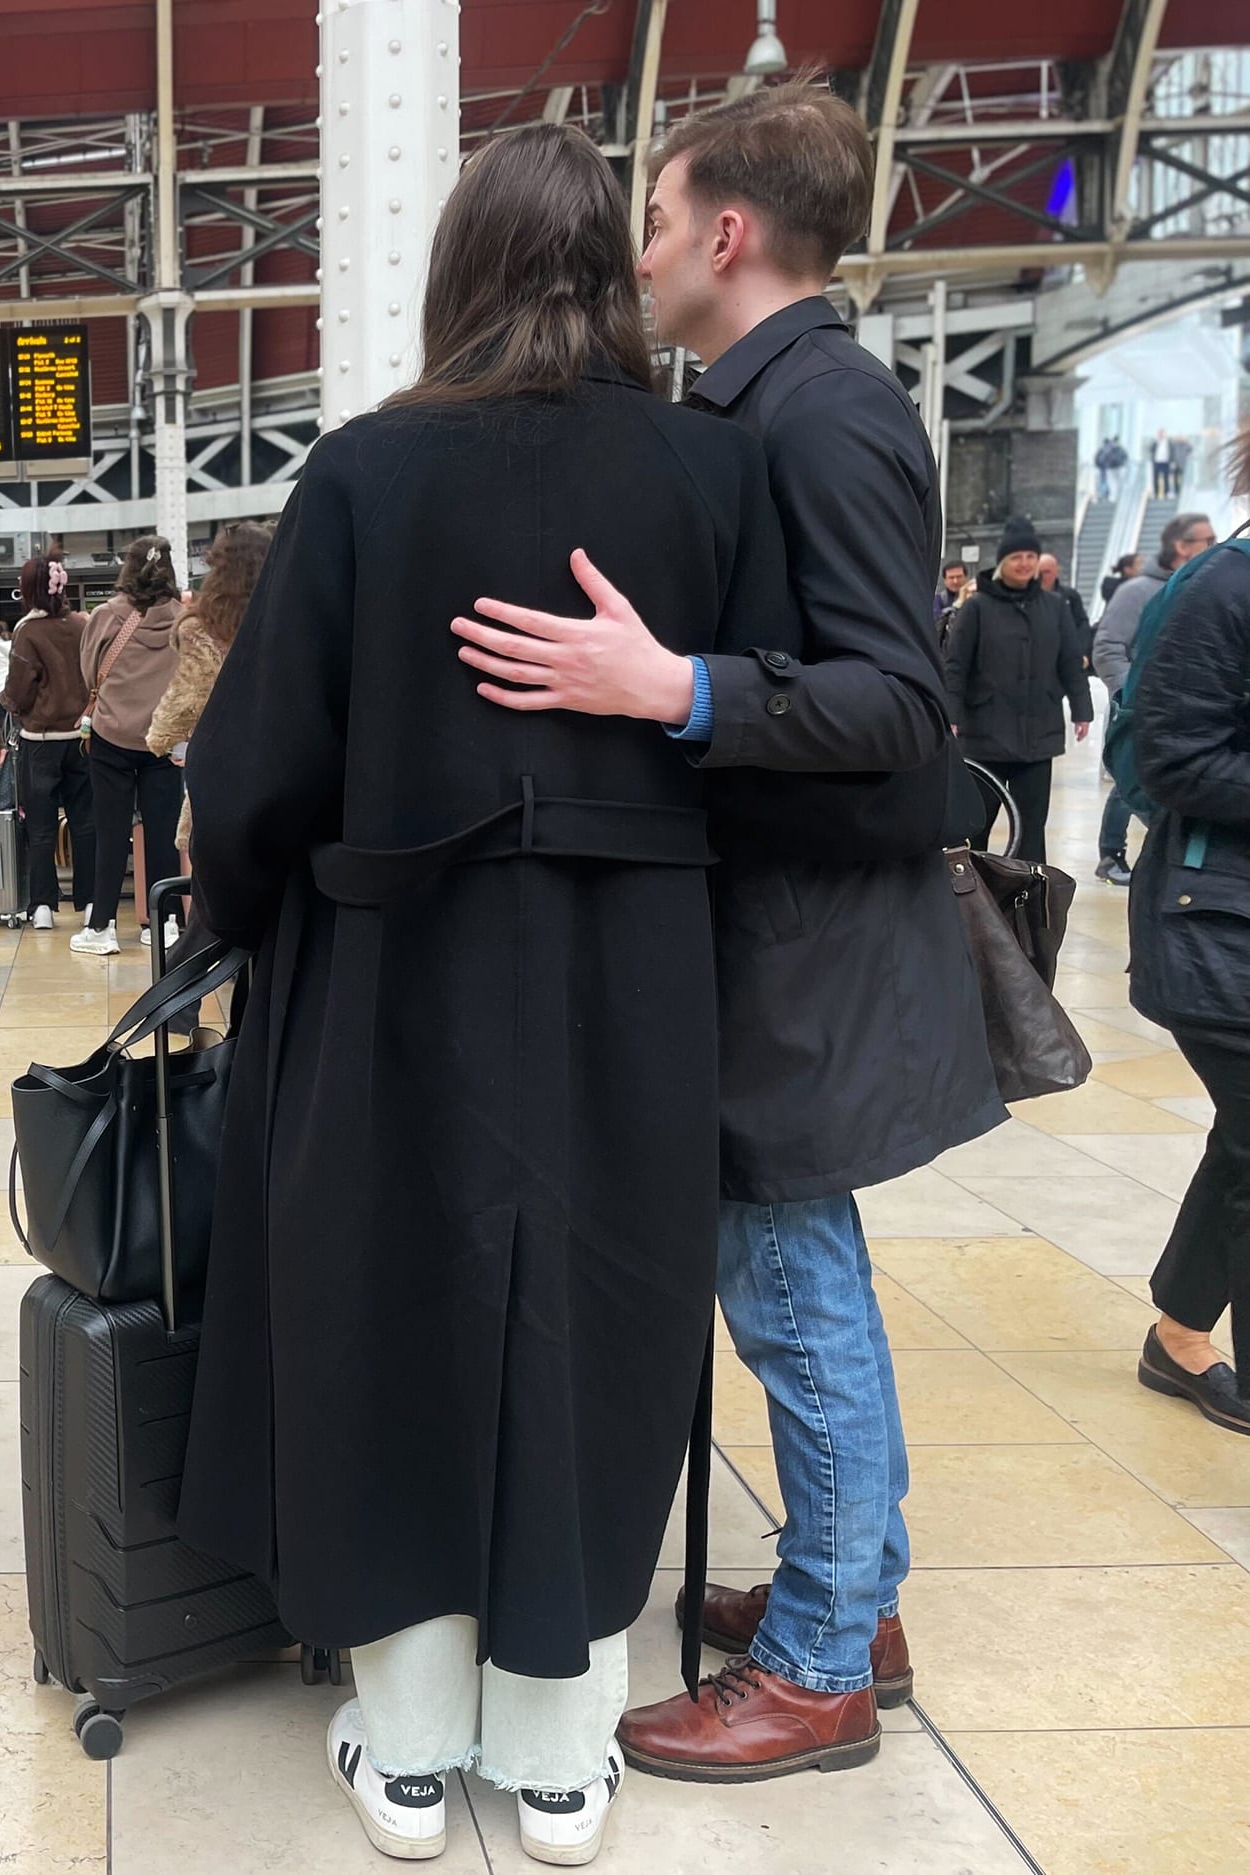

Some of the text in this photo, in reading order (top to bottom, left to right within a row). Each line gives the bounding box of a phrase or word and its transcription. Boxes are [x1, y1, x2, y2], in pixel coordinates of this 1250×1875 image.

[400, 1784, 435, 1797] VEJA
[533, 1790, 570, 1803] VEJA
[377, 1808, 397, 1827] VEJA
[575, 1819, 593, 1832] VEJA
